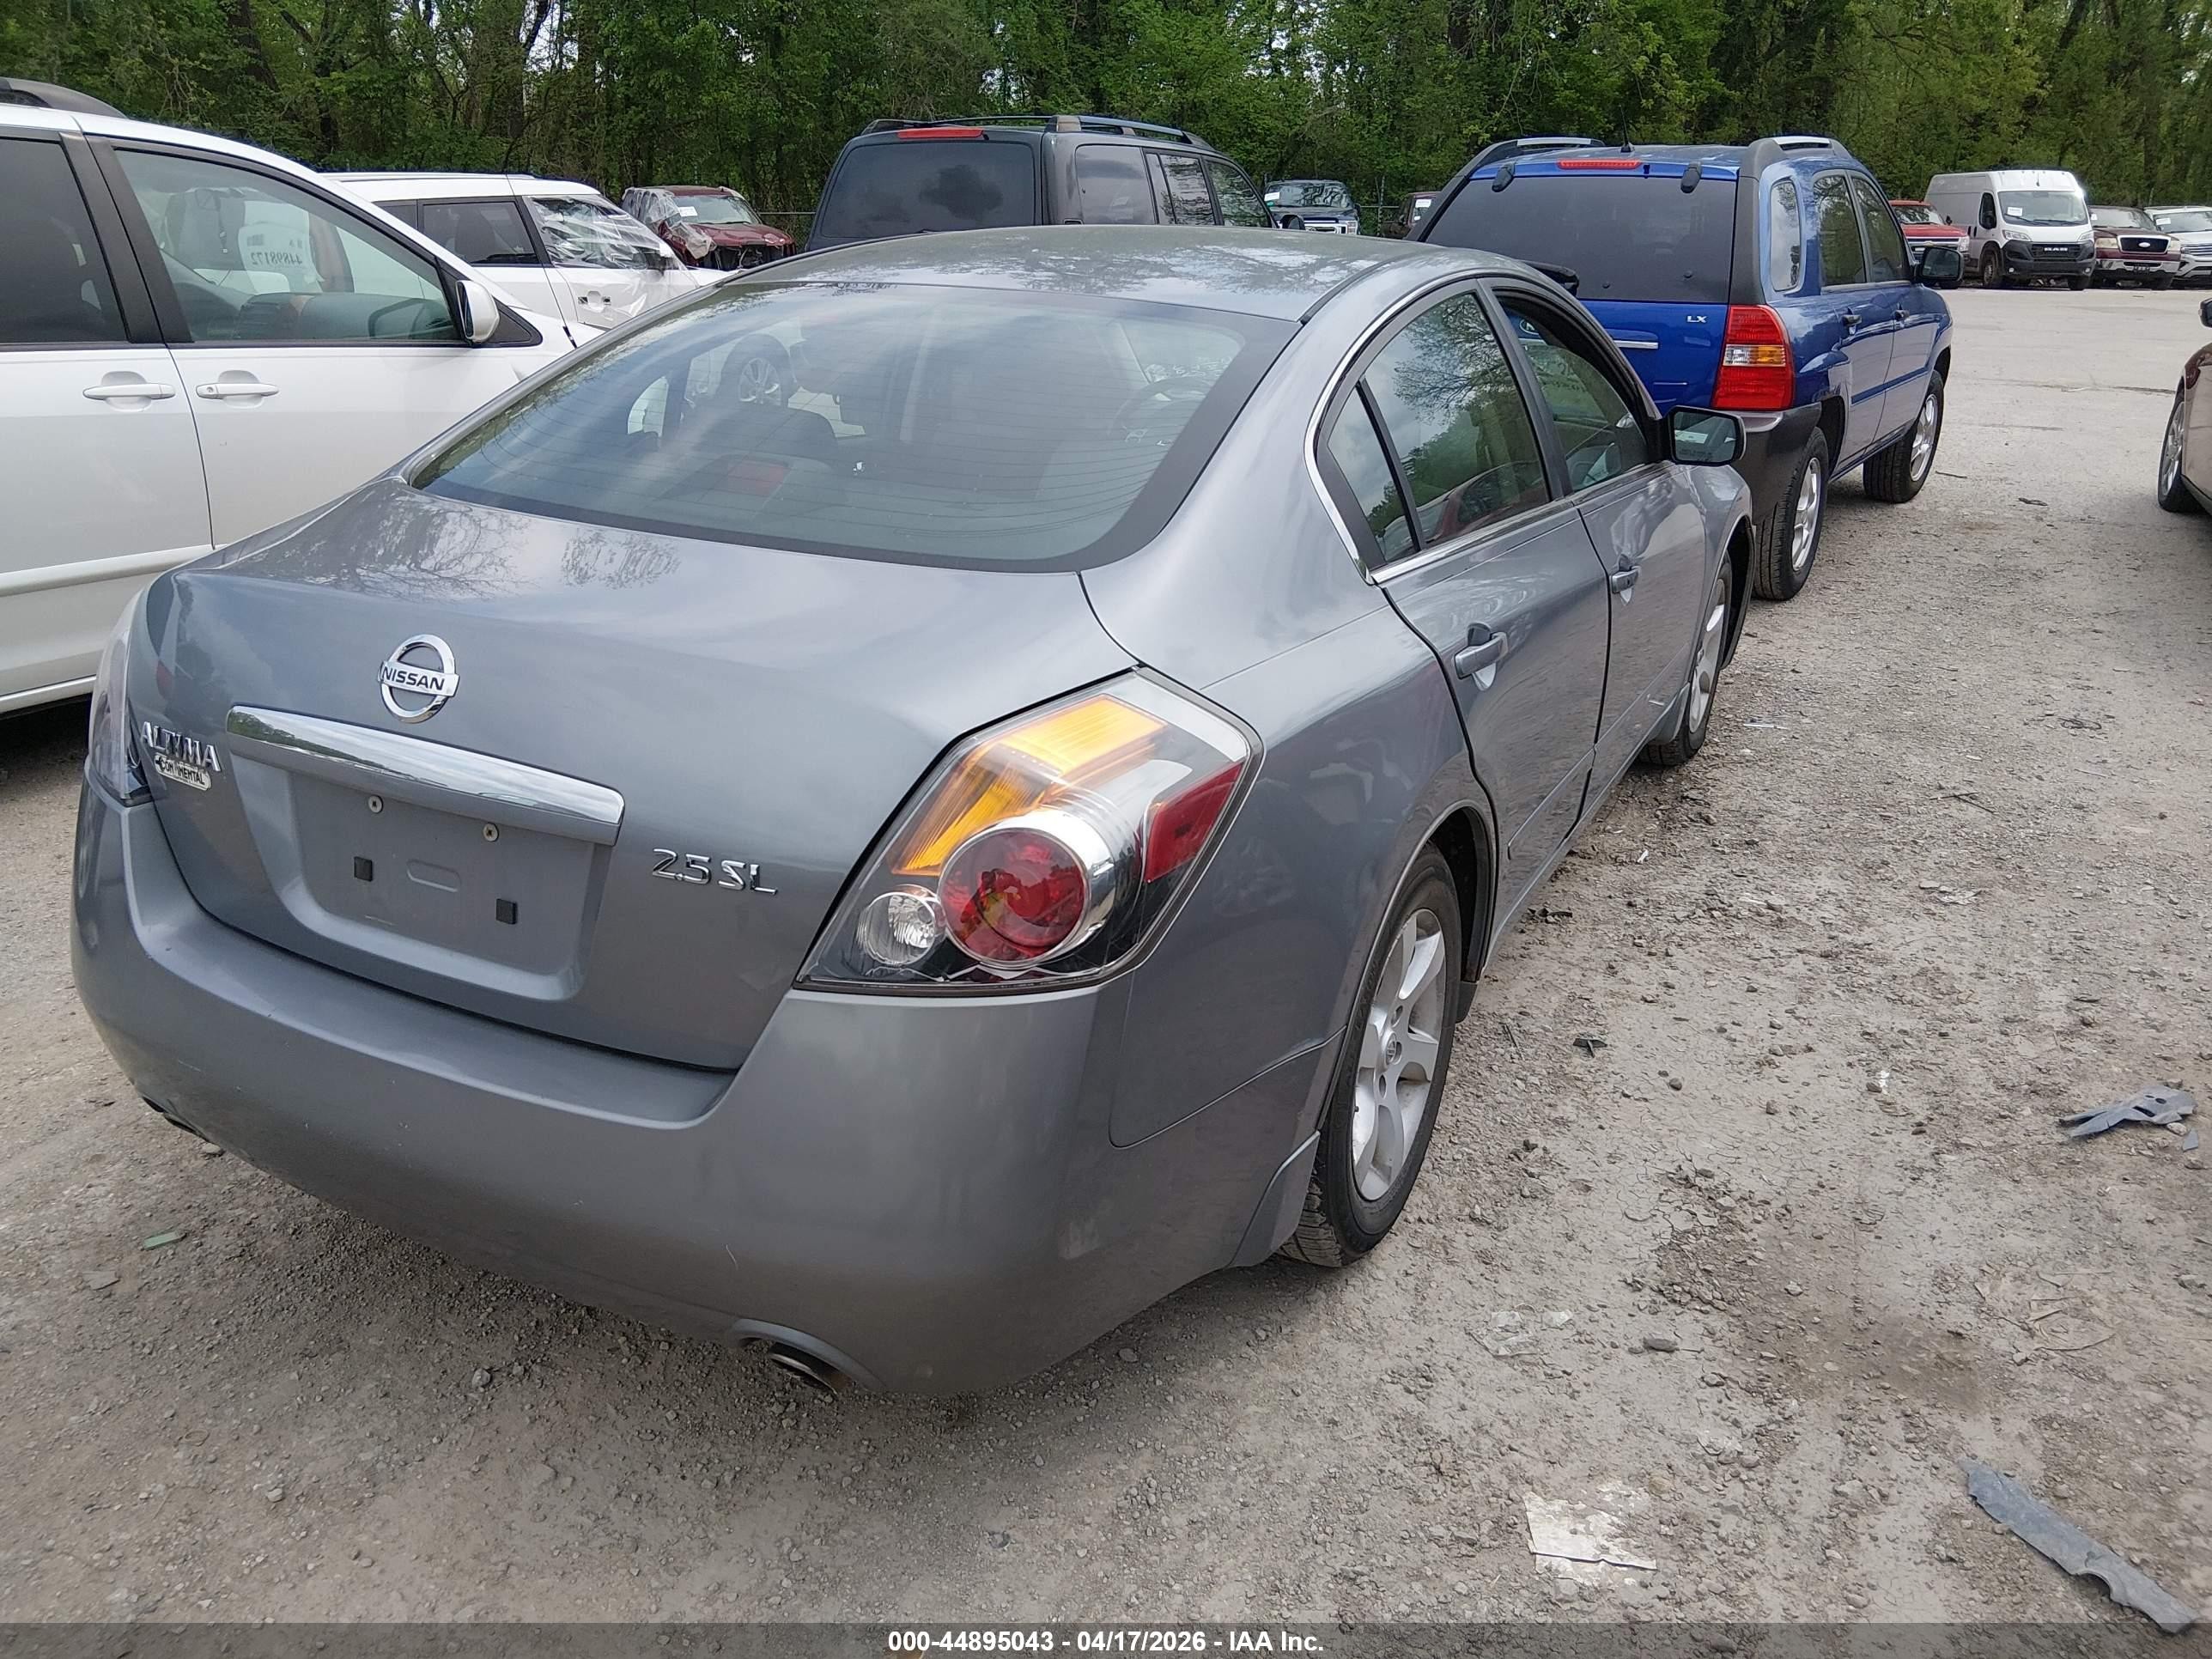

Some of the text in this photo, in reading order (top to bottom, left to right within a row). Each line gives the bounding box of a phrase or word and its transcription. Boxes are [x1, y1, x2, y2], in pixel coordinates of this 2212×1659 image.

[382, 666, 445, 690] NISSAN
[140, 721, 221, 771] ALTIMA
[158, 757, 206, 786] CONINENTAL
[653, 848, 778, 896] 2.5 SL
